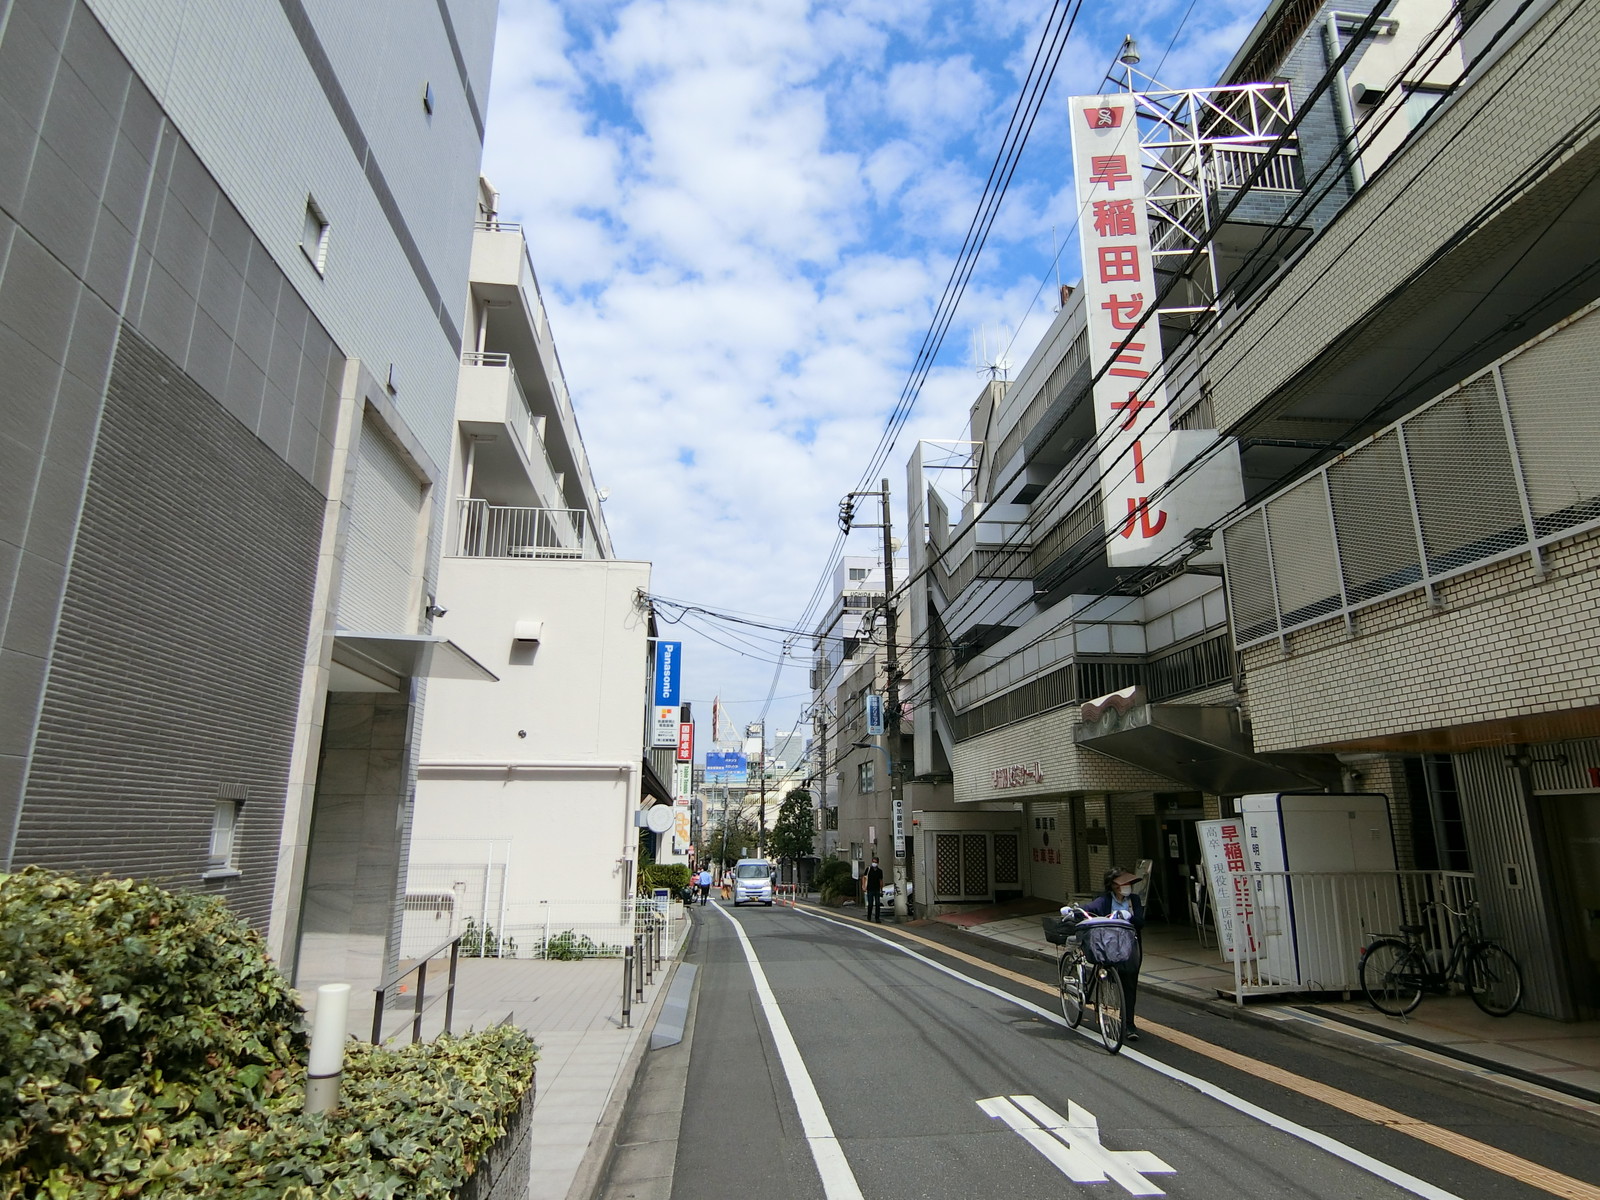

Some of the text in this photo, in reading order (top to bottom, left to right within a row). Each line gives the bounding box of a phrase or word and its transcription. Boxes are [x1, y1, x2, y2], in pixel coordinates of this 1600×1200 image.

[1088, 154, 1168, 539] 早稲田ゼミナール
[662, 644, 674, 699] Panasonic
[1205, 826, 1230, 899] 高卒・現役生
[1250, 826, 1262, 892] 証明写真
